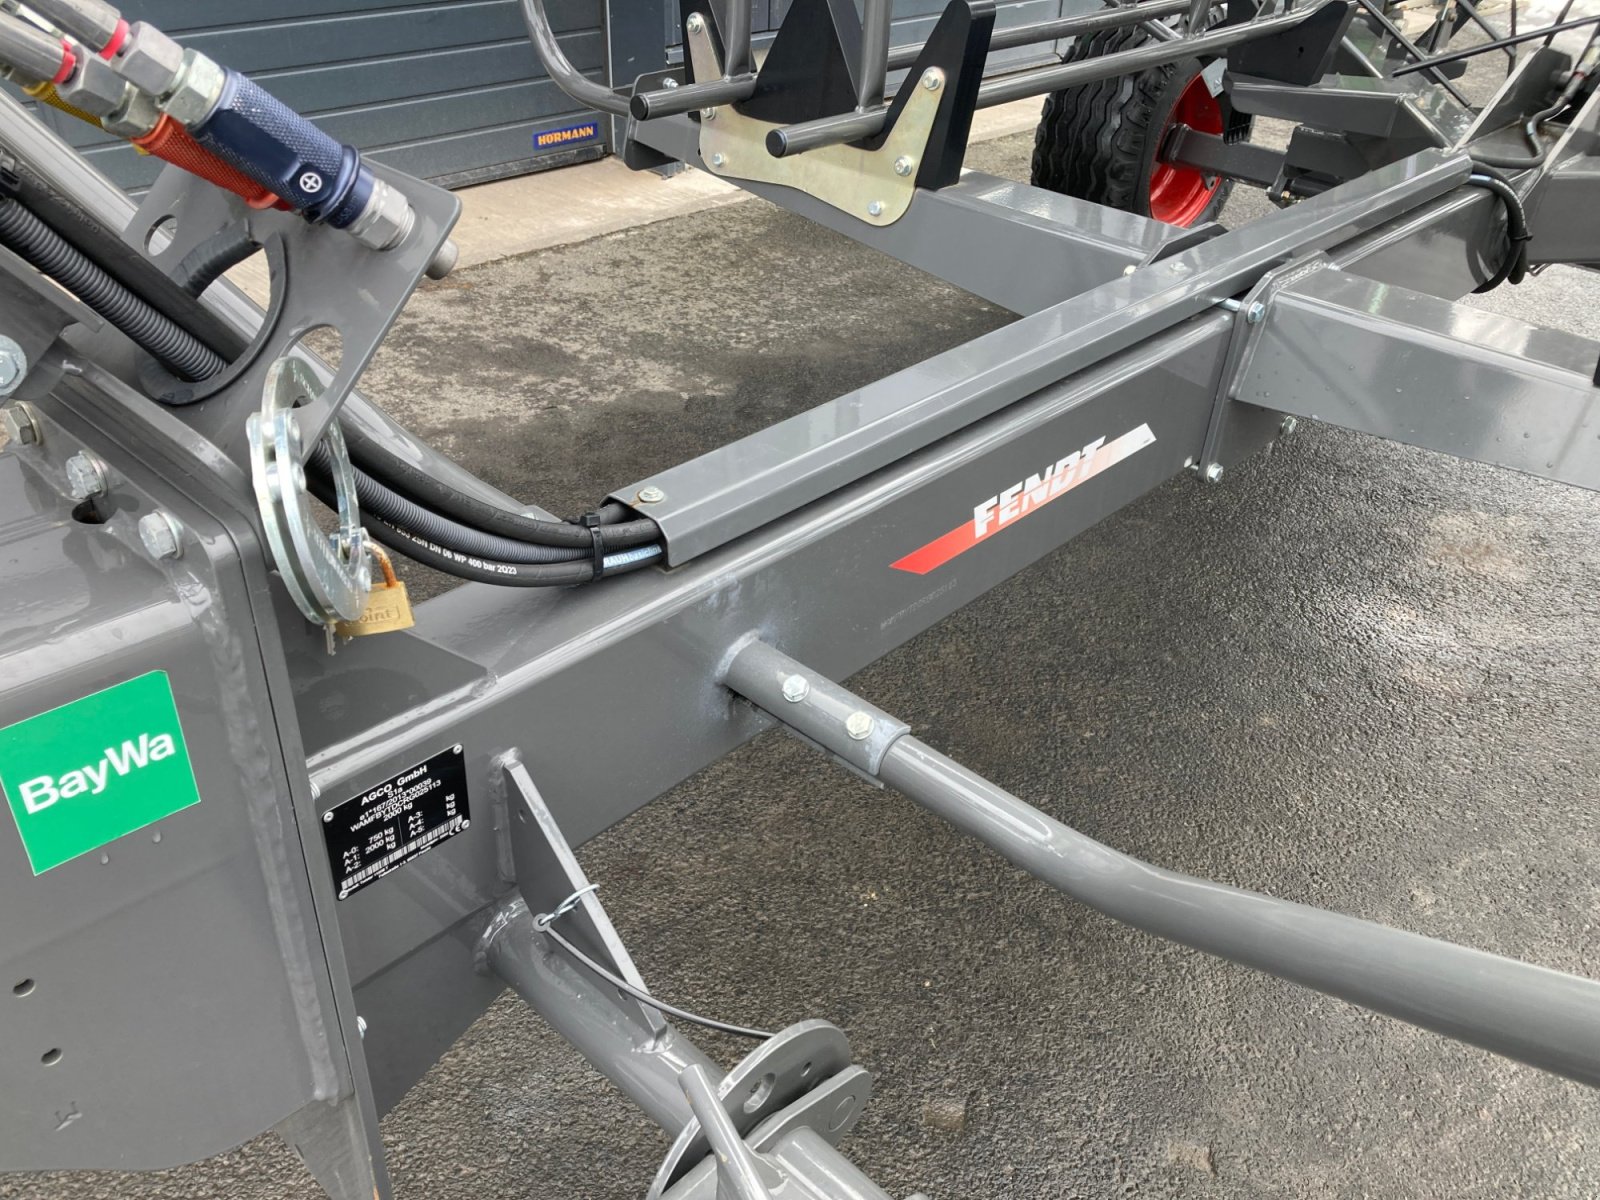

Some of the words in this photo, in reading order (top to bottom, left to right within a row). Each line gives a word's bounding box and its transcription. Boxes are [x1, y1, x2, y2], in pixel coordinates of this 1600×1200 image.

[537, 126, 594, 146] HÖRMANN
[973, 435, 1106, 539] FENDT
[429, 542, 442, 554] DN
[454, 551, 467, 563] WP
[468, 558, 482, 569] 400
[483, 561, 496, 571] bar
[18, 732, 177, 815] BayWa
[360, 784, 392, 805] AGCO
[396, 765, 427, 786] GmbH
[383, 807, 402, 821] 2000
[403, 802, 412, 811] kg
[407, 811, 423, 822] A-3:
[445, 793, 455, 802] kg
[408, 818, 424, 829] A-4:
[445, 800, 455, 809] kg
[446, 807, 456, 816] kg
[342, 845, 359, 858] A-0:
[368, 832, 383, 843] 750
[384, 826, 393, 835] kg
[343, 854, 360, 865] A-1:
[365, 840, 384, 853] 2000
[385, 834, 394, 843] kg
[344, 861, 361, 873] A-2:
[386, 841, 396, 850] kg
